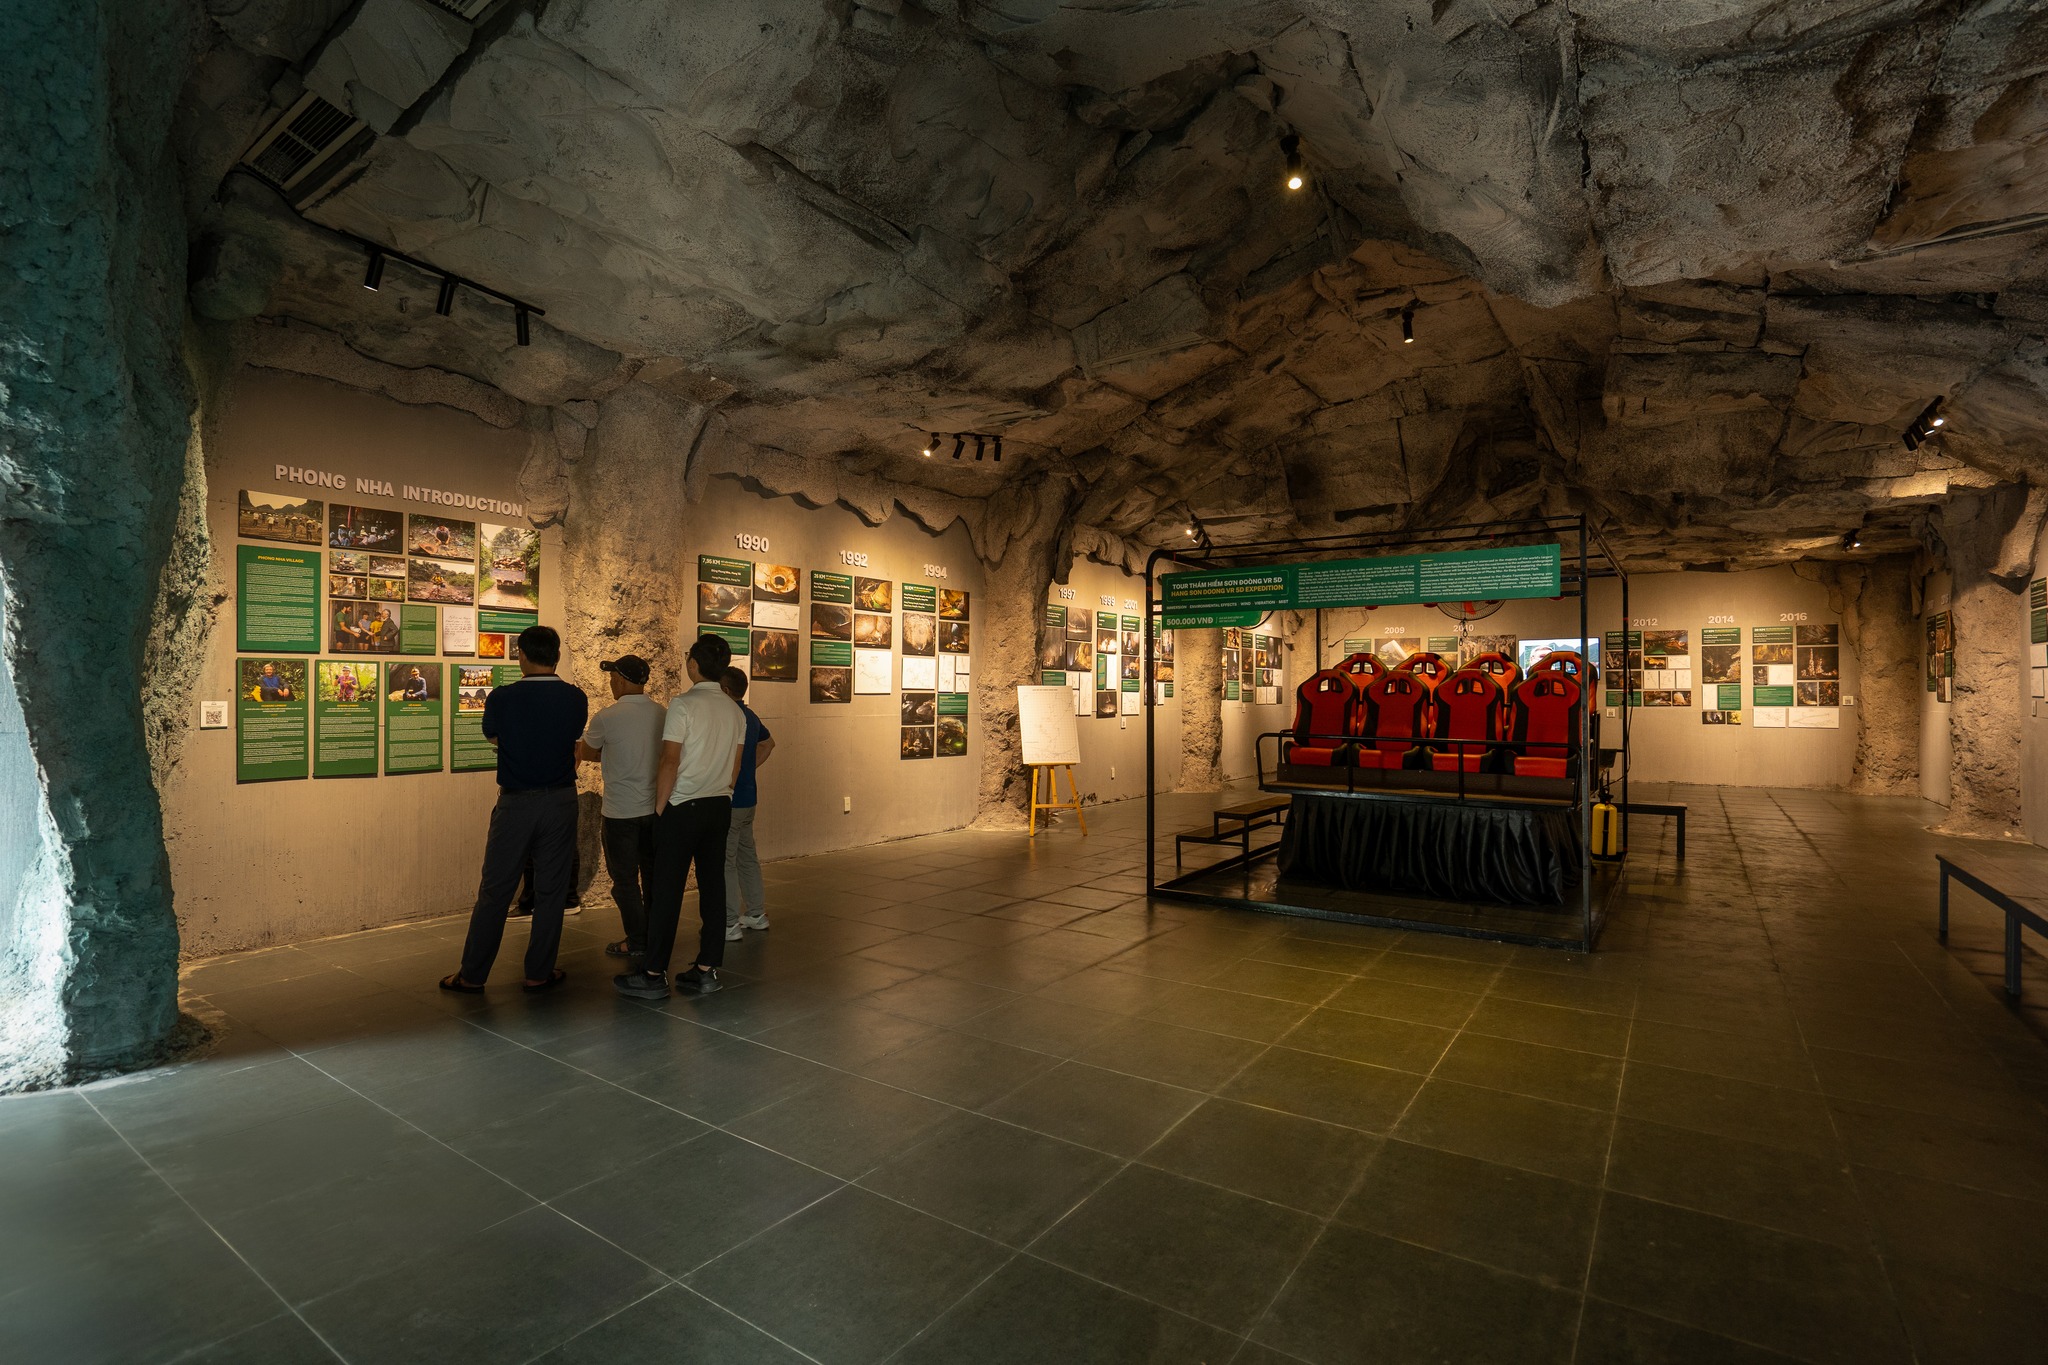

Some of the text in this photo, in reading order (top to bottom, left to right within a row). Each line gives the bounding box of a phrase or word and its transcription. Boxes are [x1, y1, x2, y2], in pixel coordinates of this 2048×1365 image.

[274, 464, 523, 518] PHONG NHA INTRODUCTION
[736, 532, 770, 552] 1990
[840, 550, 868, 568] 1992
[924, 563, 948, 579] 1994
[1060, 588, 1076, 600] 1997
[1166, 617, 1196, 626] 500.000
[1633, 618, 1658, 627] 2012
[1708, 615, 1734, 624] 2014
[1780, 612, 1807, 622] 2016
